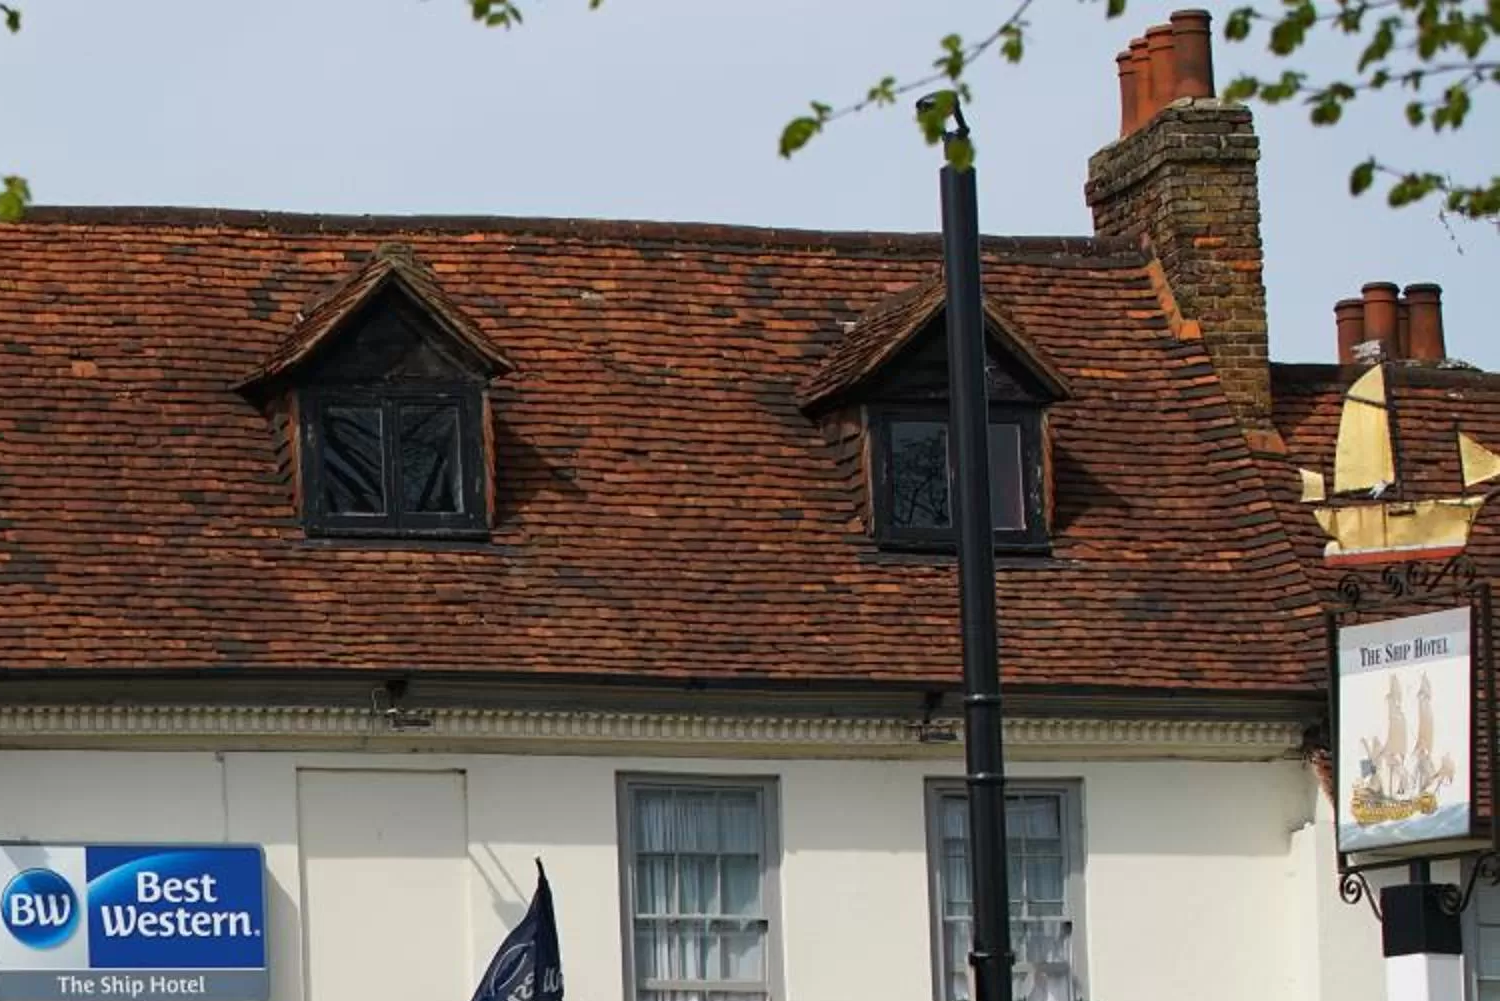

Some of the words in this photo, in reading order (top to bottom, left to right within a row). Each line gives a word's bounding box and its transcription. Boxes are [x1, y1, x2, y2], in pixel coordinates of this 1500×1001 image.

[1360, 647, 1382, 667] THE
[1385, 643, 1411, 663] SHIP
[1413, 637, 1449, 658] HOTEL
[137, 872, 218, 903] Best
[11, 893, 71, 926] BW
[57, 976, 95, 994] The
[100, 976, 145, 998] Ship
[150, 975, 205, 994] Hotel
